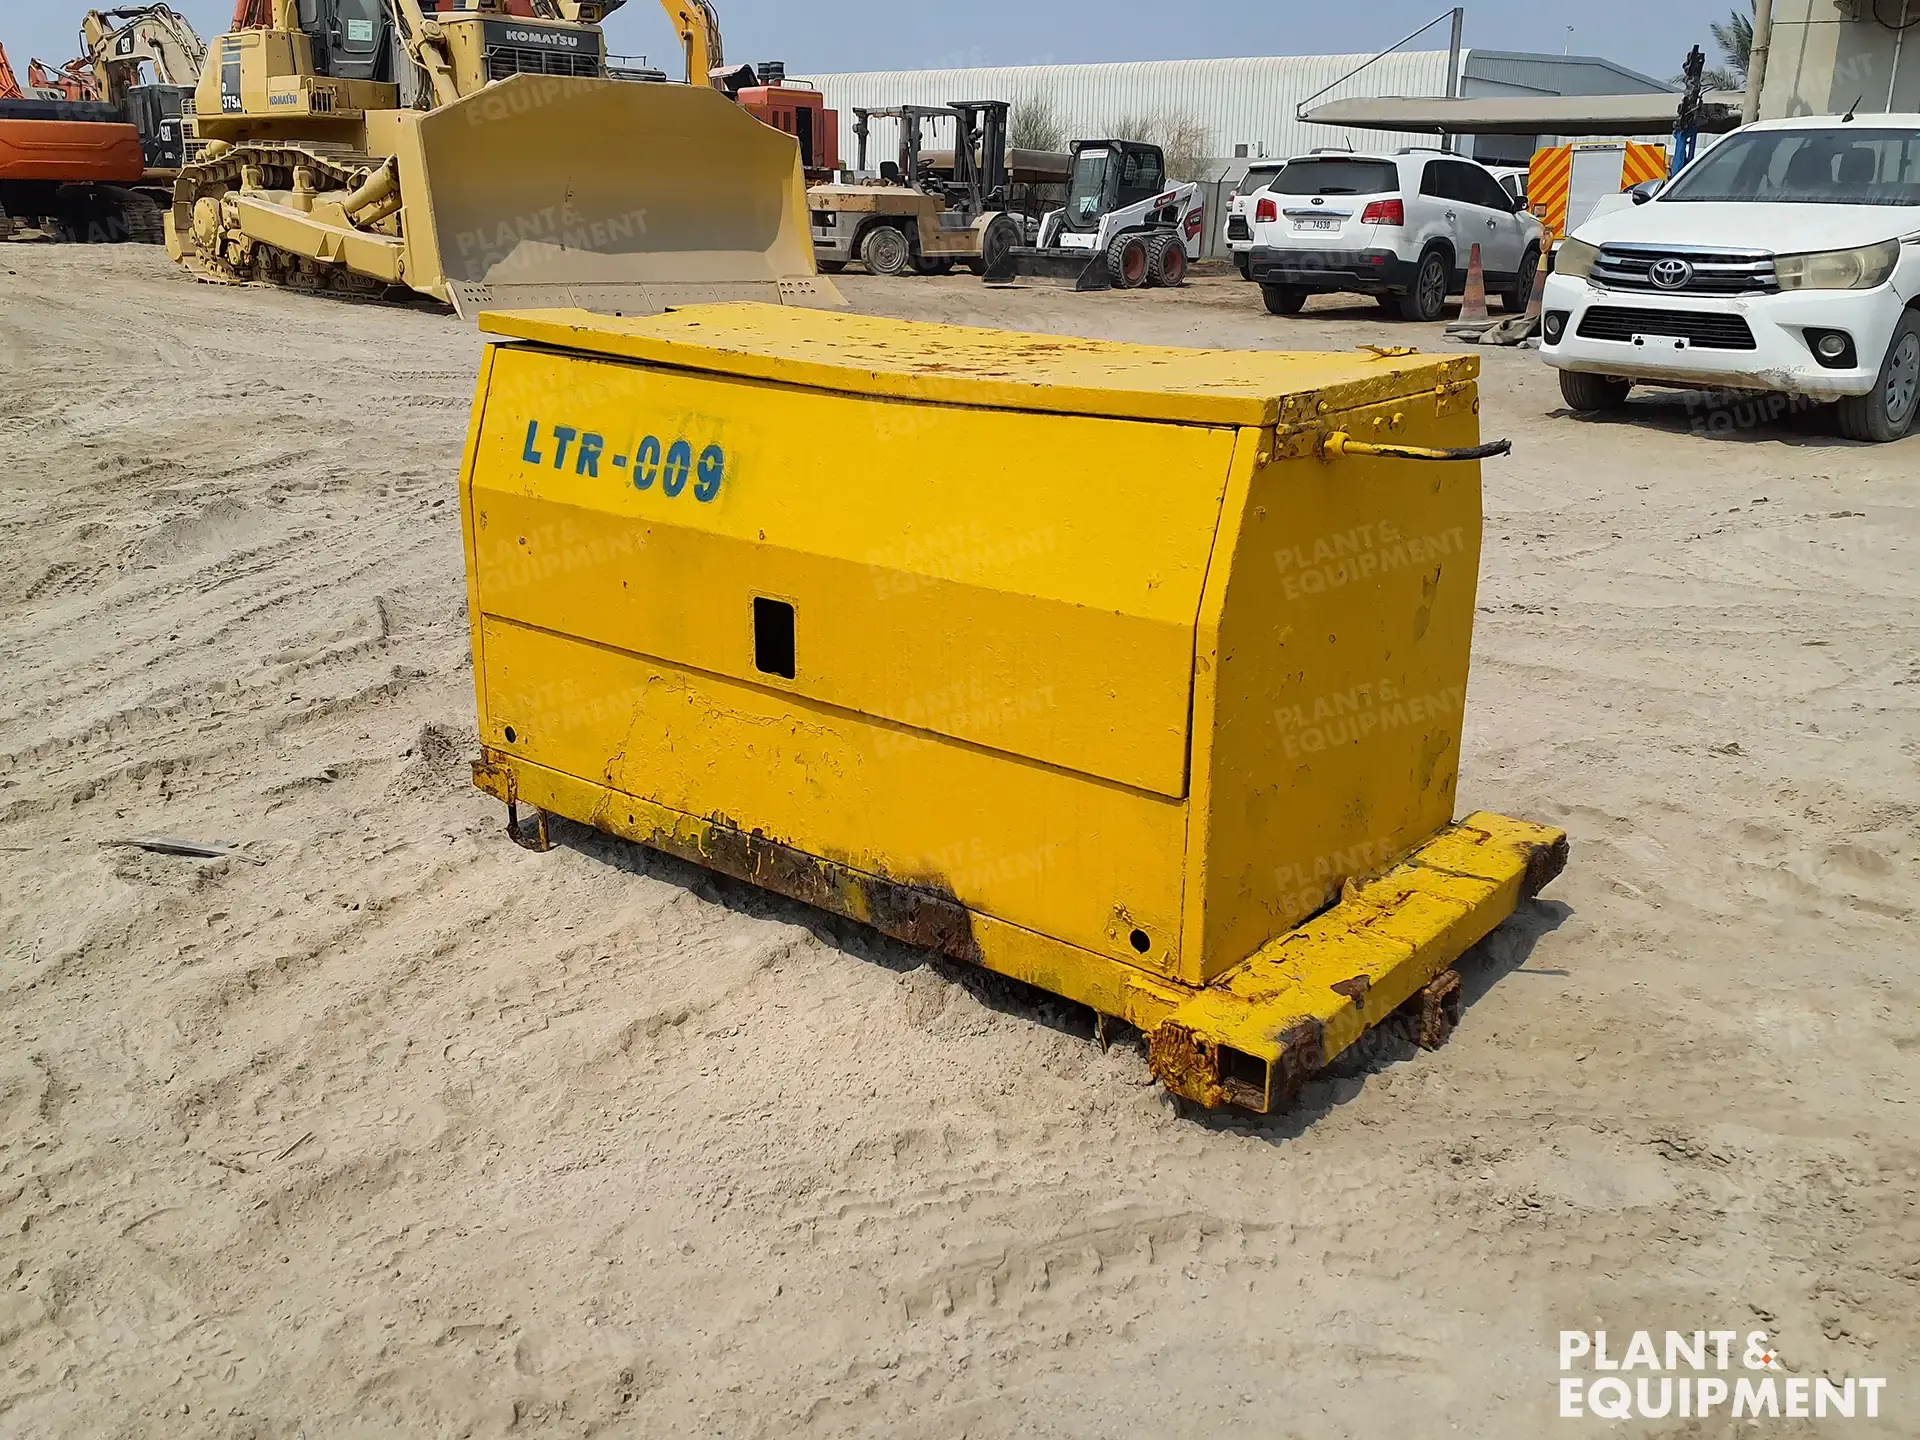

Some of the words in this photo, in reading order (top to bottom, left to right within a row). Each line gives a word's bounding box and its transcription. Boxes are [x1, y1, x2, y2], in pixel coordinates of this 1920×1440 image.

[506, 30, 578, 47] KOMATSU
[223, 96, 242, 109] 375A
[270, 94, 298, 106] KOMATSU
[1313, 220, 1331, 229] 74530
[522, 419, 725, 503] LTR-009
